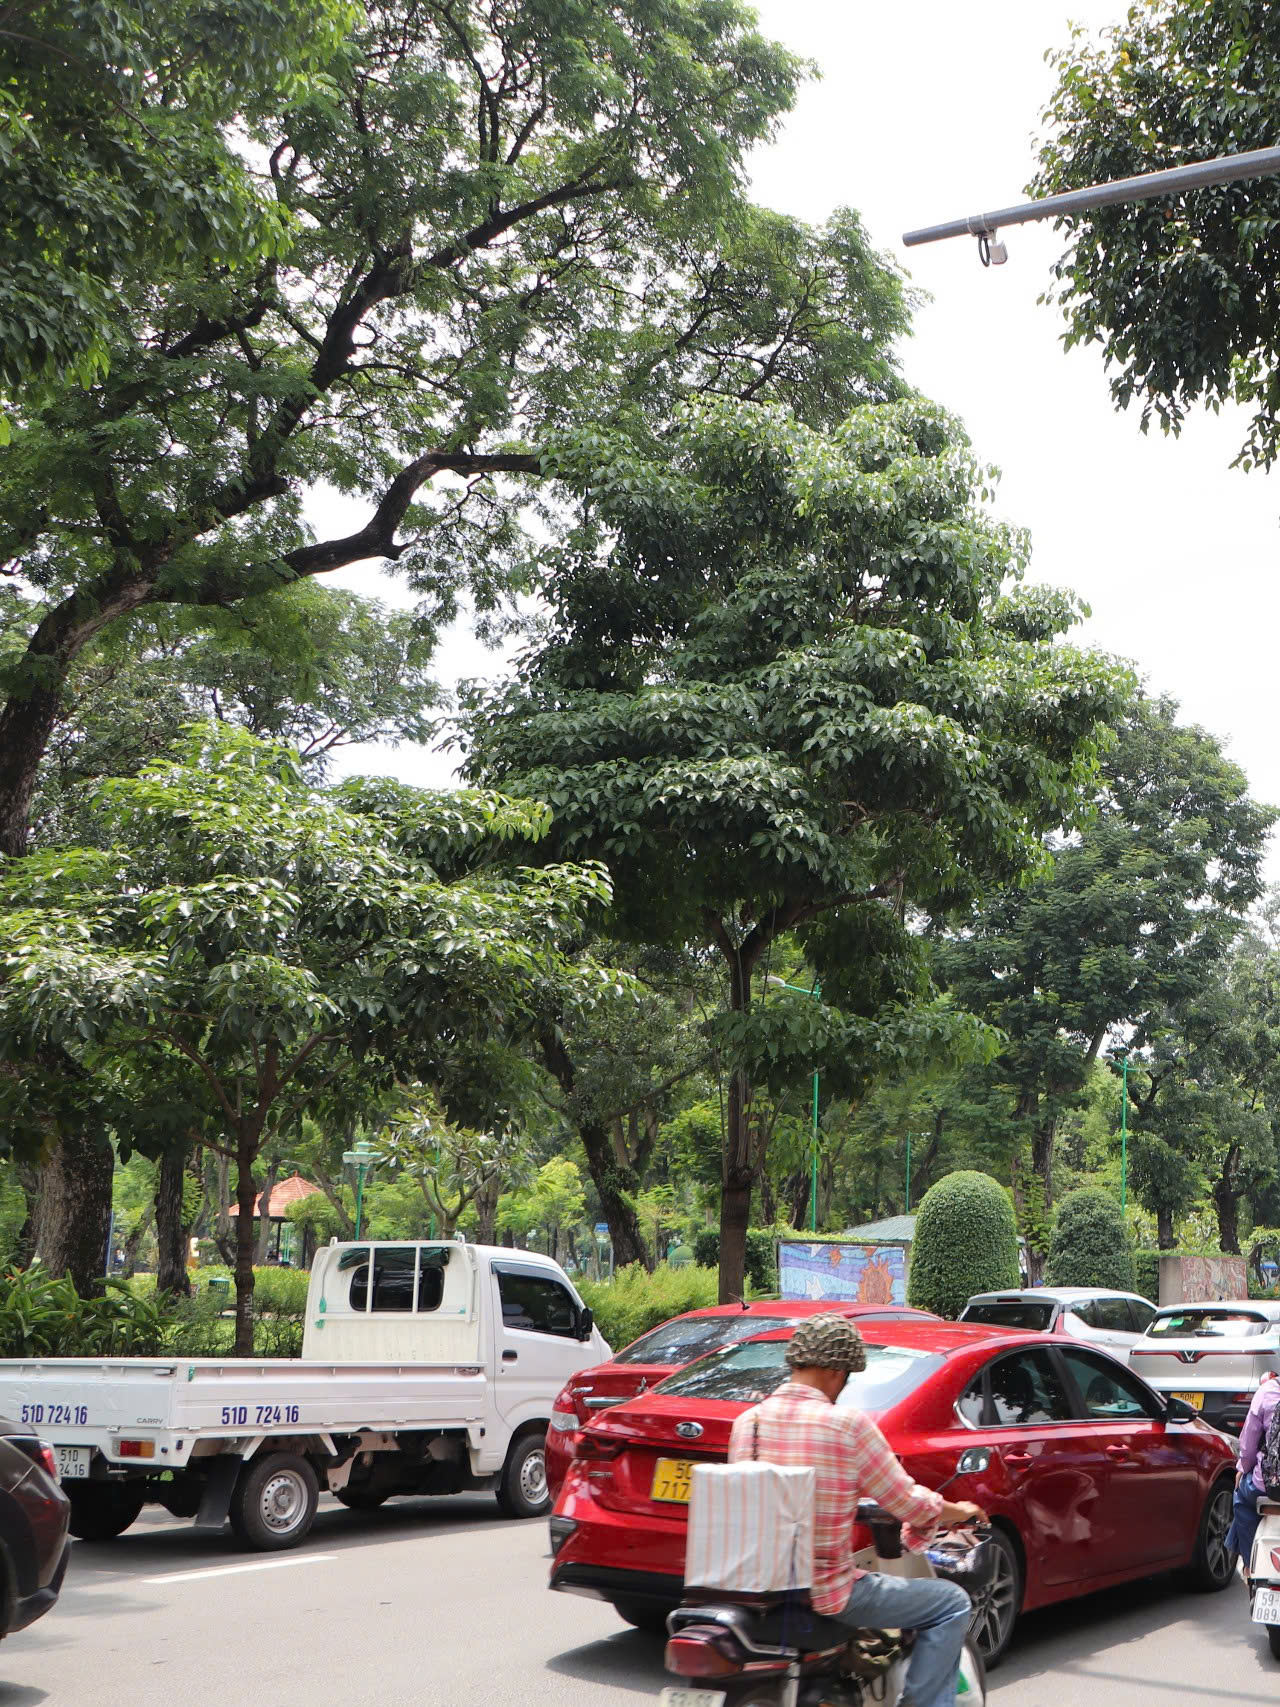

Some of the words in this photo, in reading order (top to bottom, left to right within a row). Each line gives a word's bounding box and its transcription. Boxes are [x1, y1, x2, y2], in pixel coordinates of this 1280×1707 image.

[21, 1404, 44, 1424] 51D
[136, 1417, 164, 1425] CARRY
[221, 1406, 248, 1425] 51D
[60, 1449, 79, 1462] 51D
[58, 1464, 85, 1477] 24.16
[660, 1480, 690, 1499] 717
